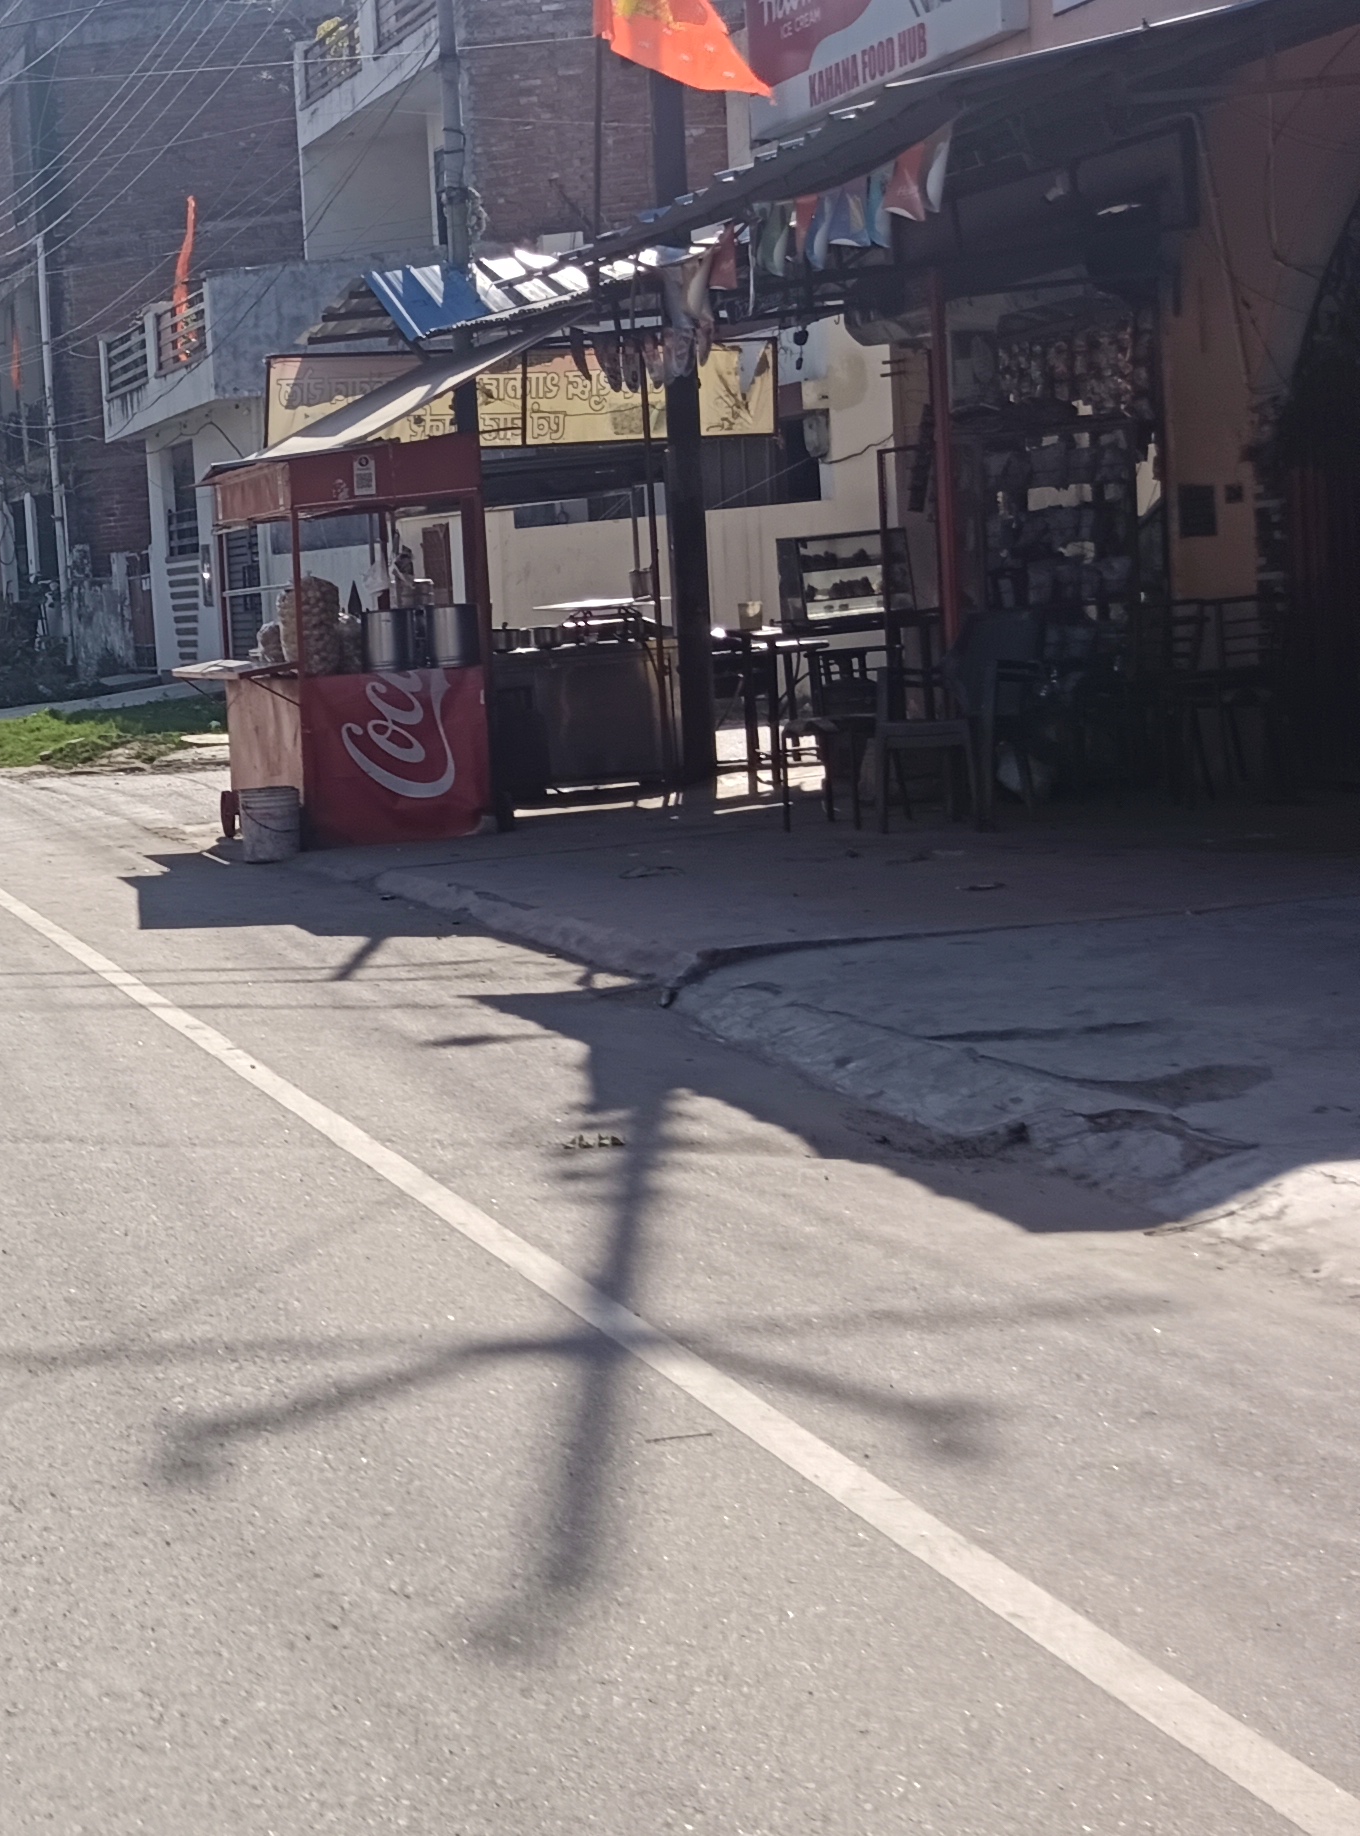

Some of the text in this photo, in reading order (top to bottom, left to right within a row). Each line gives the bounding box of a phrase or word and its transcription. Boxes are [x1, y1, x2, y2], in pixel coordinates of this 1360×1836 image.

[795, 7, 821, 32] CREAM
[808, 22, 927, 108] KAHANA FOOD HUB
